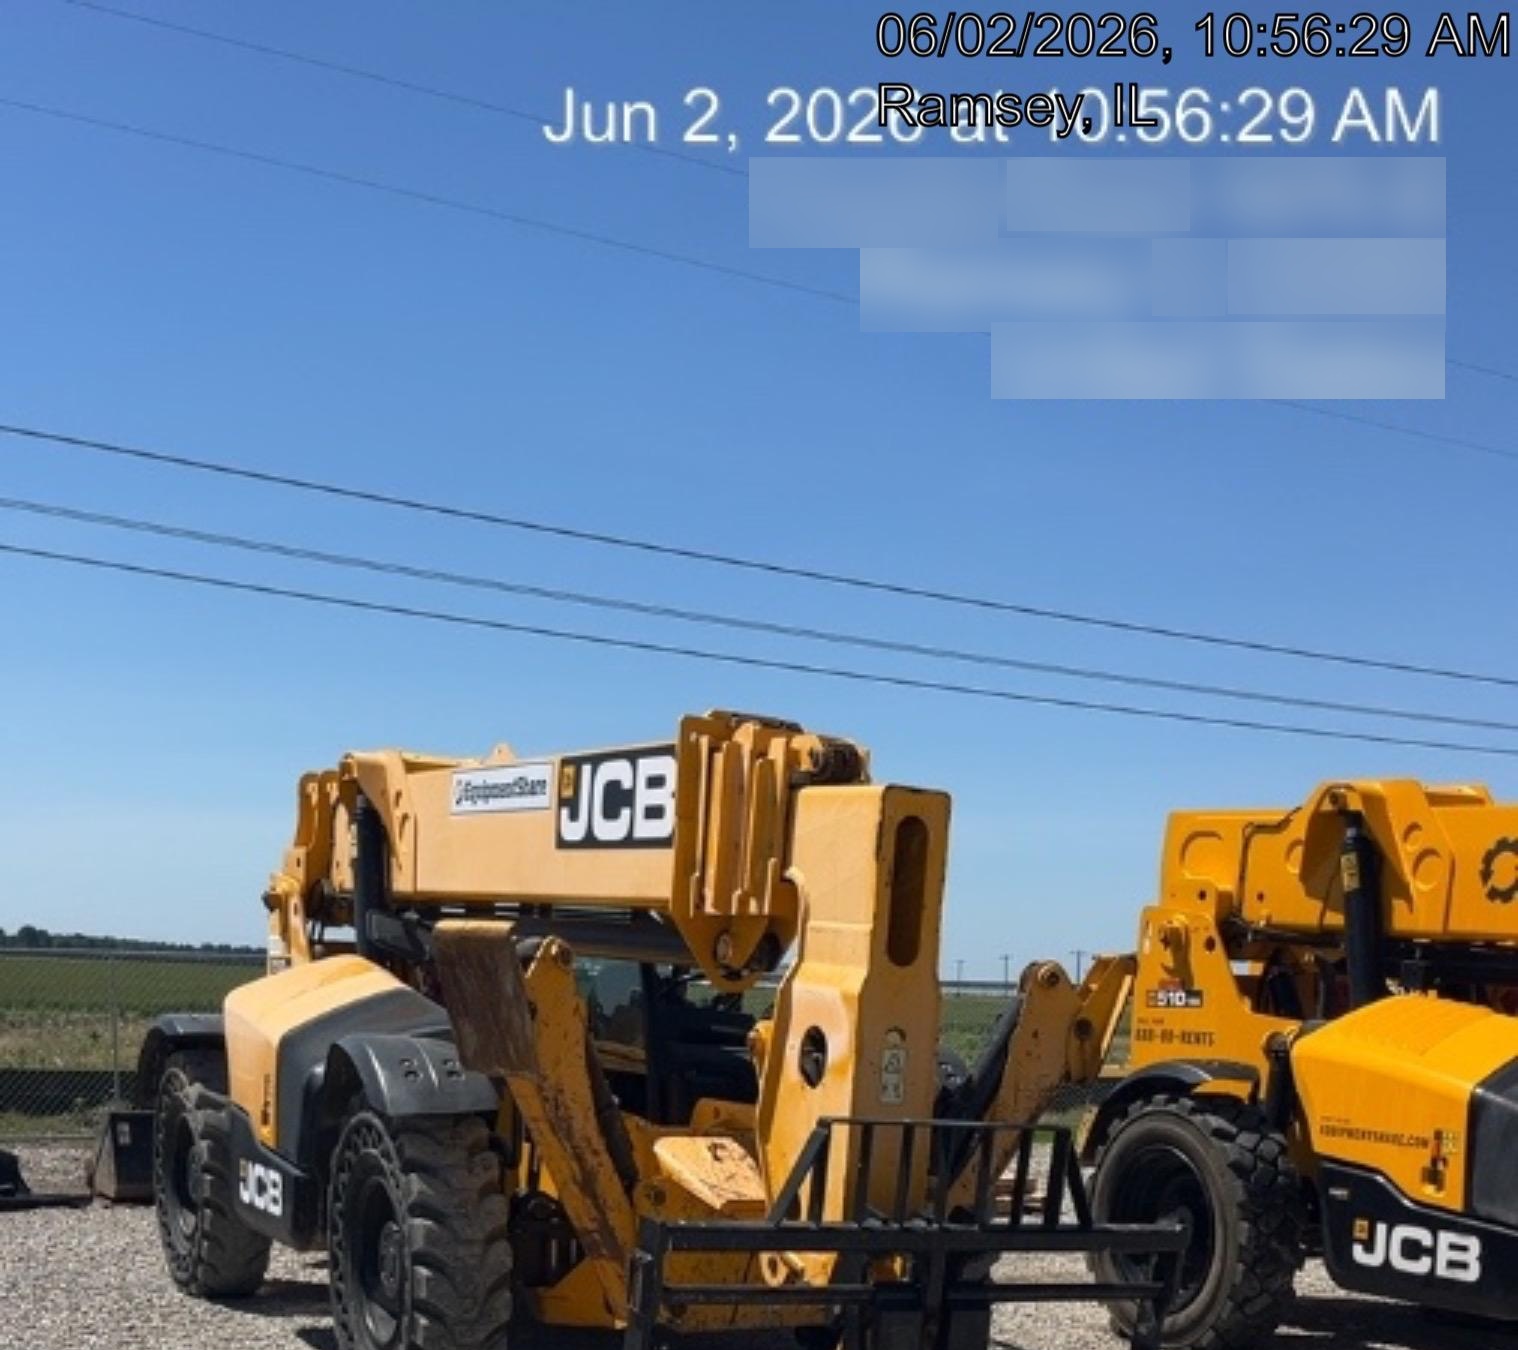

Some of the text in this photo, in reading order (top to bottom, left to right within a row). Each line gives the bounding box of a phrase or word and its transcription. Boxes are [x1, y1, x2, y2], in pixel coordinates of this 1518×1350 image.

[560, 756, 678, 841] JCB
[240, 1159, 282, 1217] JCB
[1352, 1221, 1481, 1283] JCB
